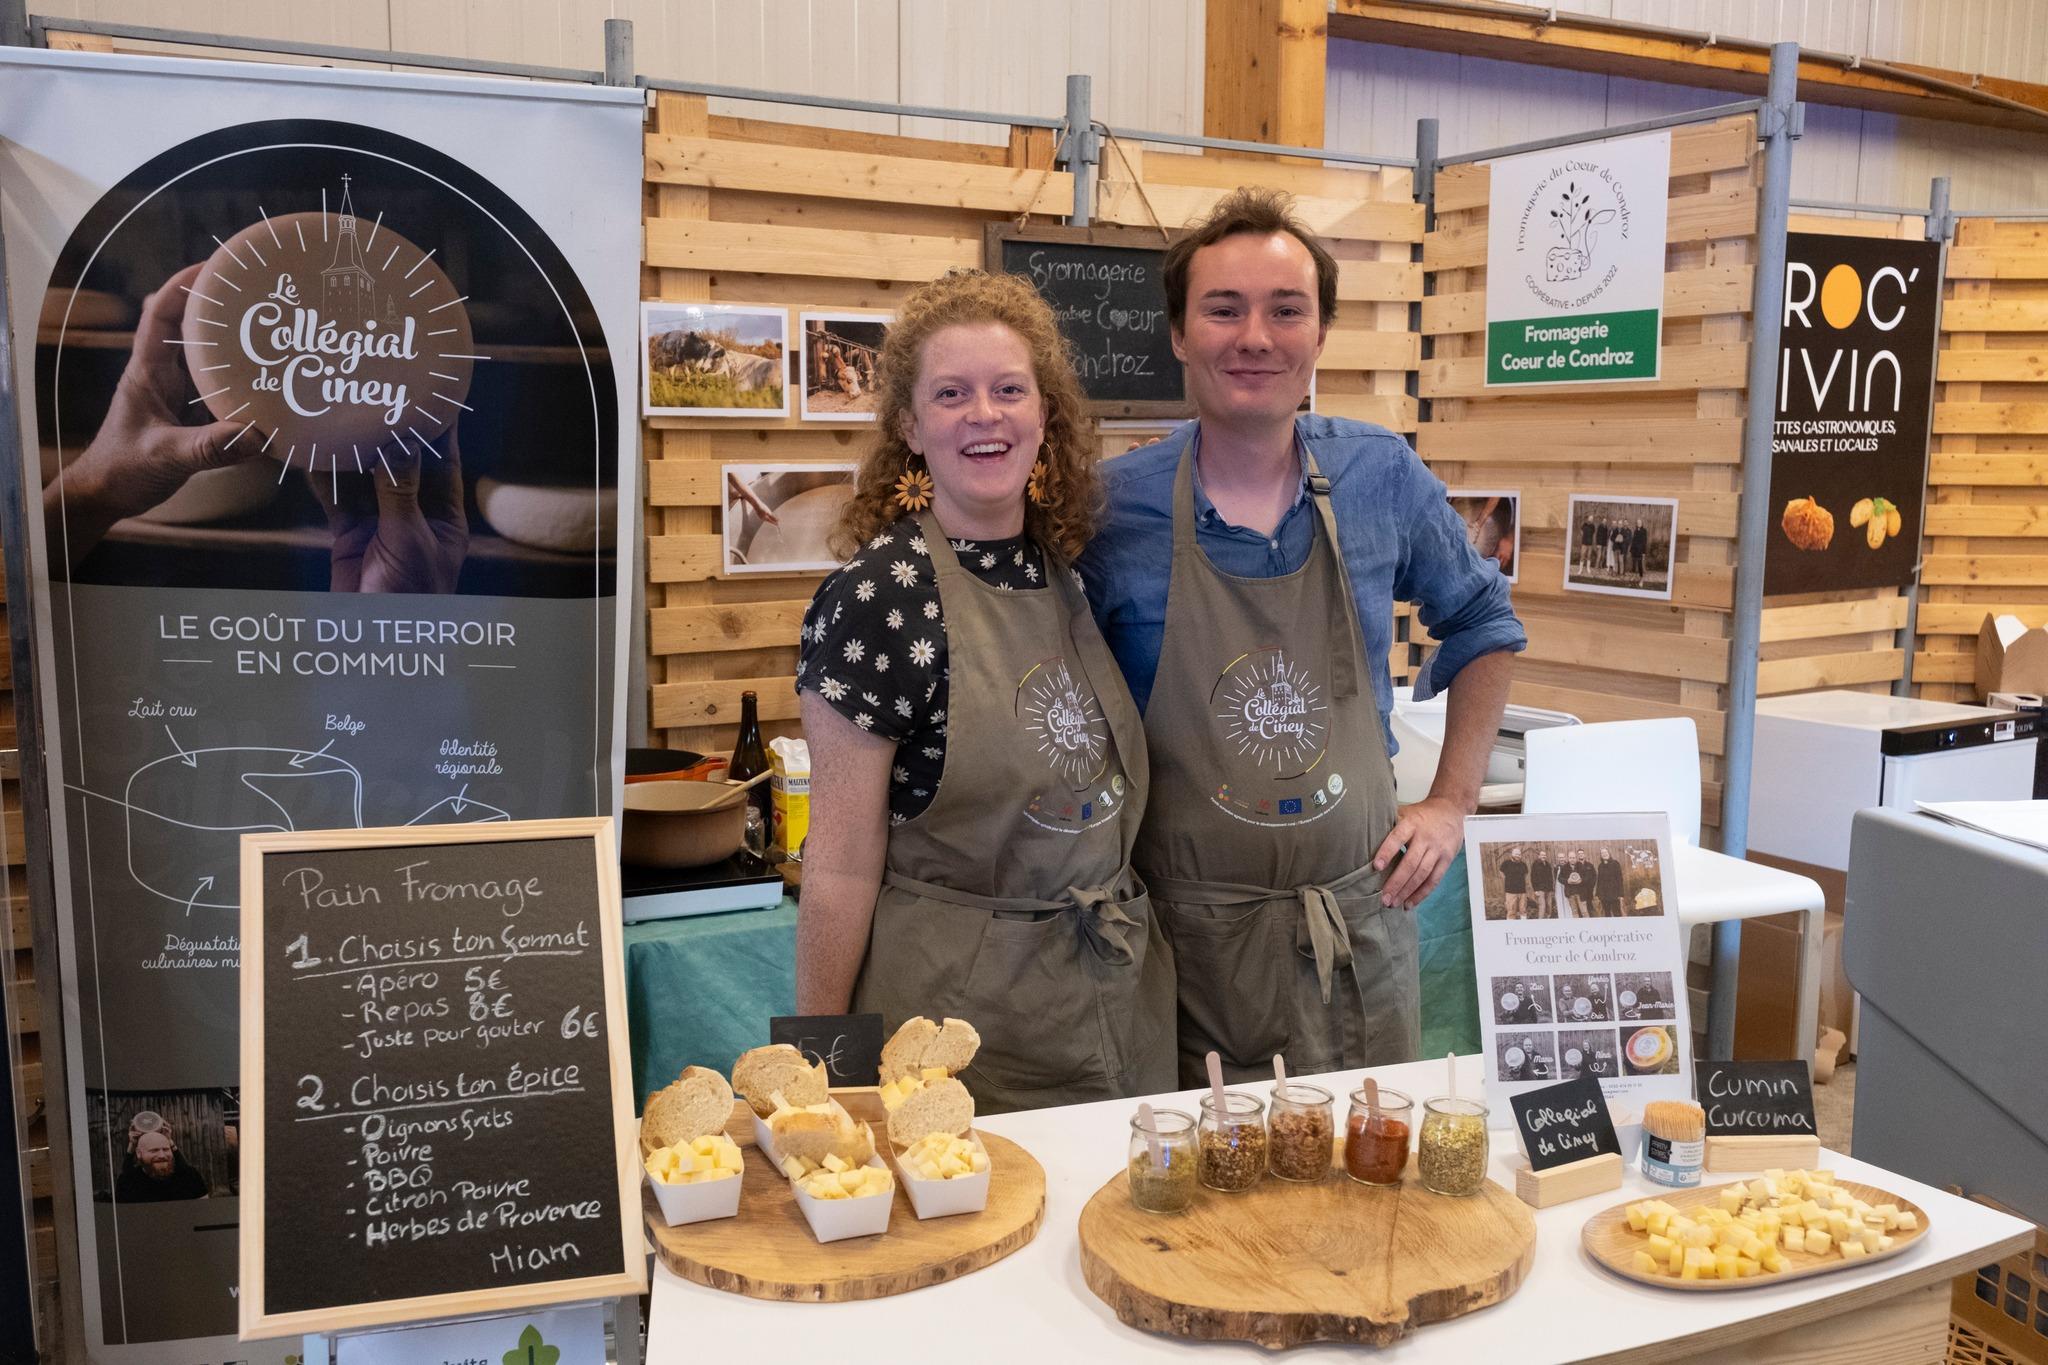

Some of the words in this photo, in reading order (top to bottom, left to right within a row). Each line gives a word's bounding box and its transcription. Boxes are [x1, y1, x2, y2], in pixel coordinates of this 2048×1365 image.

[1516, 180, 1547, 252] Fromagerie
[1549, 167, 1563, 181] du
[1565, 160, 1599, 172] Coeur
[1600, 168, 1612, 183] de
[1612, 182, 1631, 240] Condroz
[268, 273, 301, 306] Le
[1576, 284, 1604, 308] DEPUIS
[1602, 264, 1618, 288] 2022
[1784, 262, 1920, 332] ROC'
[240, 302, 418, 374] Collégial
[1524, 320, 1609, 345] Fromagerie
[1073, 337, 1155, 379] ondroz
[1501, 352, 1544, 370] Coeur
[1547, 350, 1566, 368] de
[1569, 346, 1634, 368] Condroz
[252, 367, 282, 392] de
[282, 354, 411, 426] Ciney
[1773, 421, 1801, 435] TTES
[1802, 420, 1896, 436] GASTRONOMIQUES,
[1772, 438, 1818, 453] SANALES
[1820, 439, 1833, 452] ET
[1834, 438, 1878, 452] LOCALES
[160, 615, 199, 640] LE
[210, 612, 305, 642] GOÛT
[317, 619, 363, 643] DU
[372, 619, 516, 647] TERROIR
[237, 650, 281, 675] EN
[293, 651, 445, 677] COMMUN
[1254, 688, 1266, 699] Le
[128, 697, 165, 719] Lait
[169, 706, 197, 717] cru
[1244, 697, 1307, 722] Collégial
[325, 714, 366, 736] Belge
[1249, 721, 1260, 732] de
[1260, 715, 1305, 739] Ciney
[440, 739, 498, 756] Identité
[435, 758, 503, 780] régionale
[282, 867, 381, 909] Pain
[394, 860, 543, 917] Fromage
[165, 933, 240, 958] Dégustati
[339, 935, 441, 965] Choisis
[452, 927, 495, 952] ton
[501, 921, 590, 963] format
[1505, 931, 1576, 948] Fromagerie
[1579, 929, 1653, 948] Coopérative
[142, 953, 218, 969] culinaires
[1565, 949, 1580, 963] de
[1583, 949, 1637, 963] Condroz
[356, 969, 439, 1000] Apéro
[464, 966, 510, 993] 5€
[360, 997, 450, 1024] Repas
[469, 992, 513, 1022] 8€
[359, 1029, 414, 1059] Juste
[424, 1026, 472, 1048] pour
[476, 1020, 545, 1049] gouter
[560, 1005, 600, 1040] 6€
[351, 1073, 450, 1106] Choisis
[456, 1072, 496, 1098] ton
[506, 1062, 580, 1095] épice
[1709, 1070, 1799, 1098] Cumin
[1708, 1104, 1813, 1130] Curcuma
[361, 1142, 434, 1168] Poivre
[1537, 1137, 1556, 1156] de
[1558, 1131, 1599, 1152] Ciney
[362, 1164, 434, 1193] BBQ
[365, 1187, 448, 1217] Citron
[451, 1178, 530, 1200] Poivre
[366, 1216, 450, 1247] Herbes
[457, 1208, 489, 1232] de
[493, 1199, 602, 1228] Provence
[489, 1241, 581, 1274] Miam
